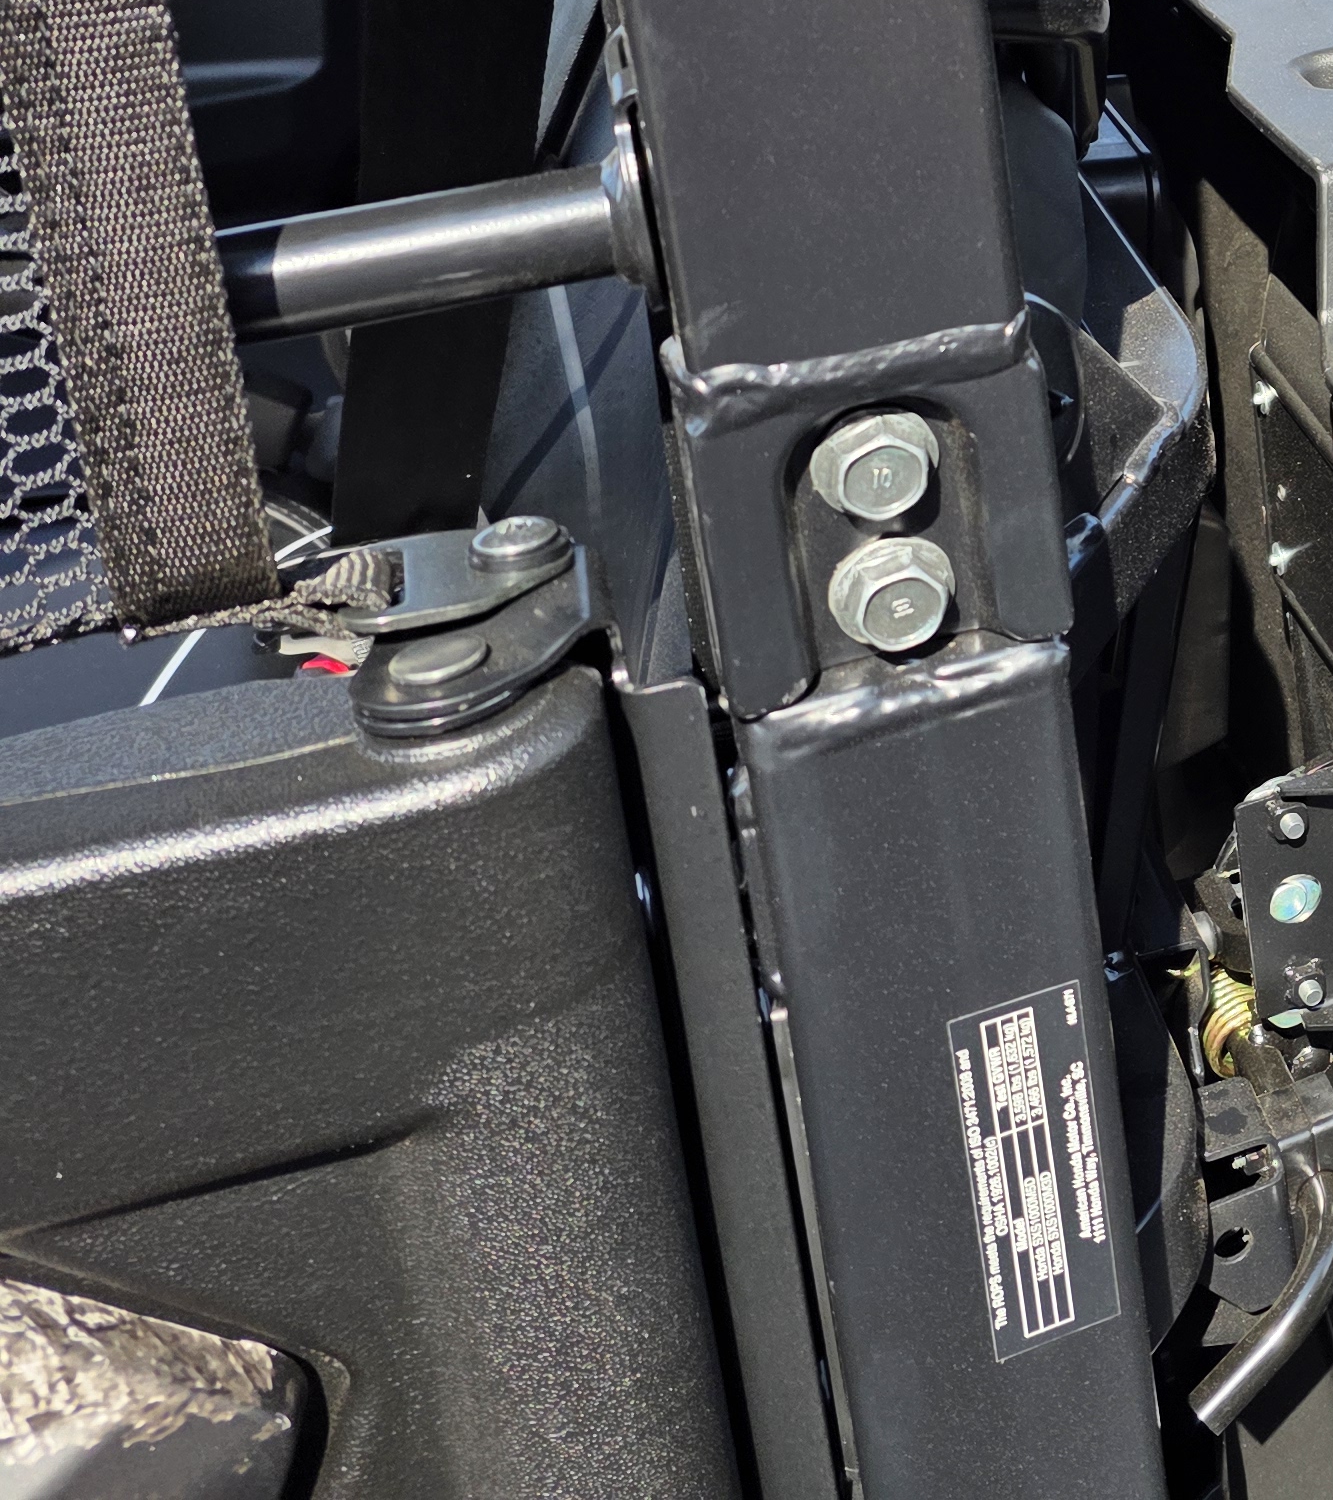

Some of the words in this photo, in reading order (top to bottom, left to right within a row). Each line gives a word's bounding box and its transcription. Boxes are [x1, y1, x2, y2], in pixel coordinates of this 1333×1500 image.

[988, 1046, 1005, 1085] GVWR
[1069, 1060, 1085, 1081] SC
[993, 1082, 1009, 1112] Test
[1065, 1120, 1081, 1154] Motor
[1068, 1151, 1086, 1189] Honda
[1075, 1187, 1093, 1239] American
[1086, 1179, 1103, 1218] Honda
[1012, 1217, 1029, 1253] Model
[1091, 1216, 1107, 1244] 1111
[1034, 1245, 1049, 1282] Honda
[1049, 1239, 1065, 1276] Honda
